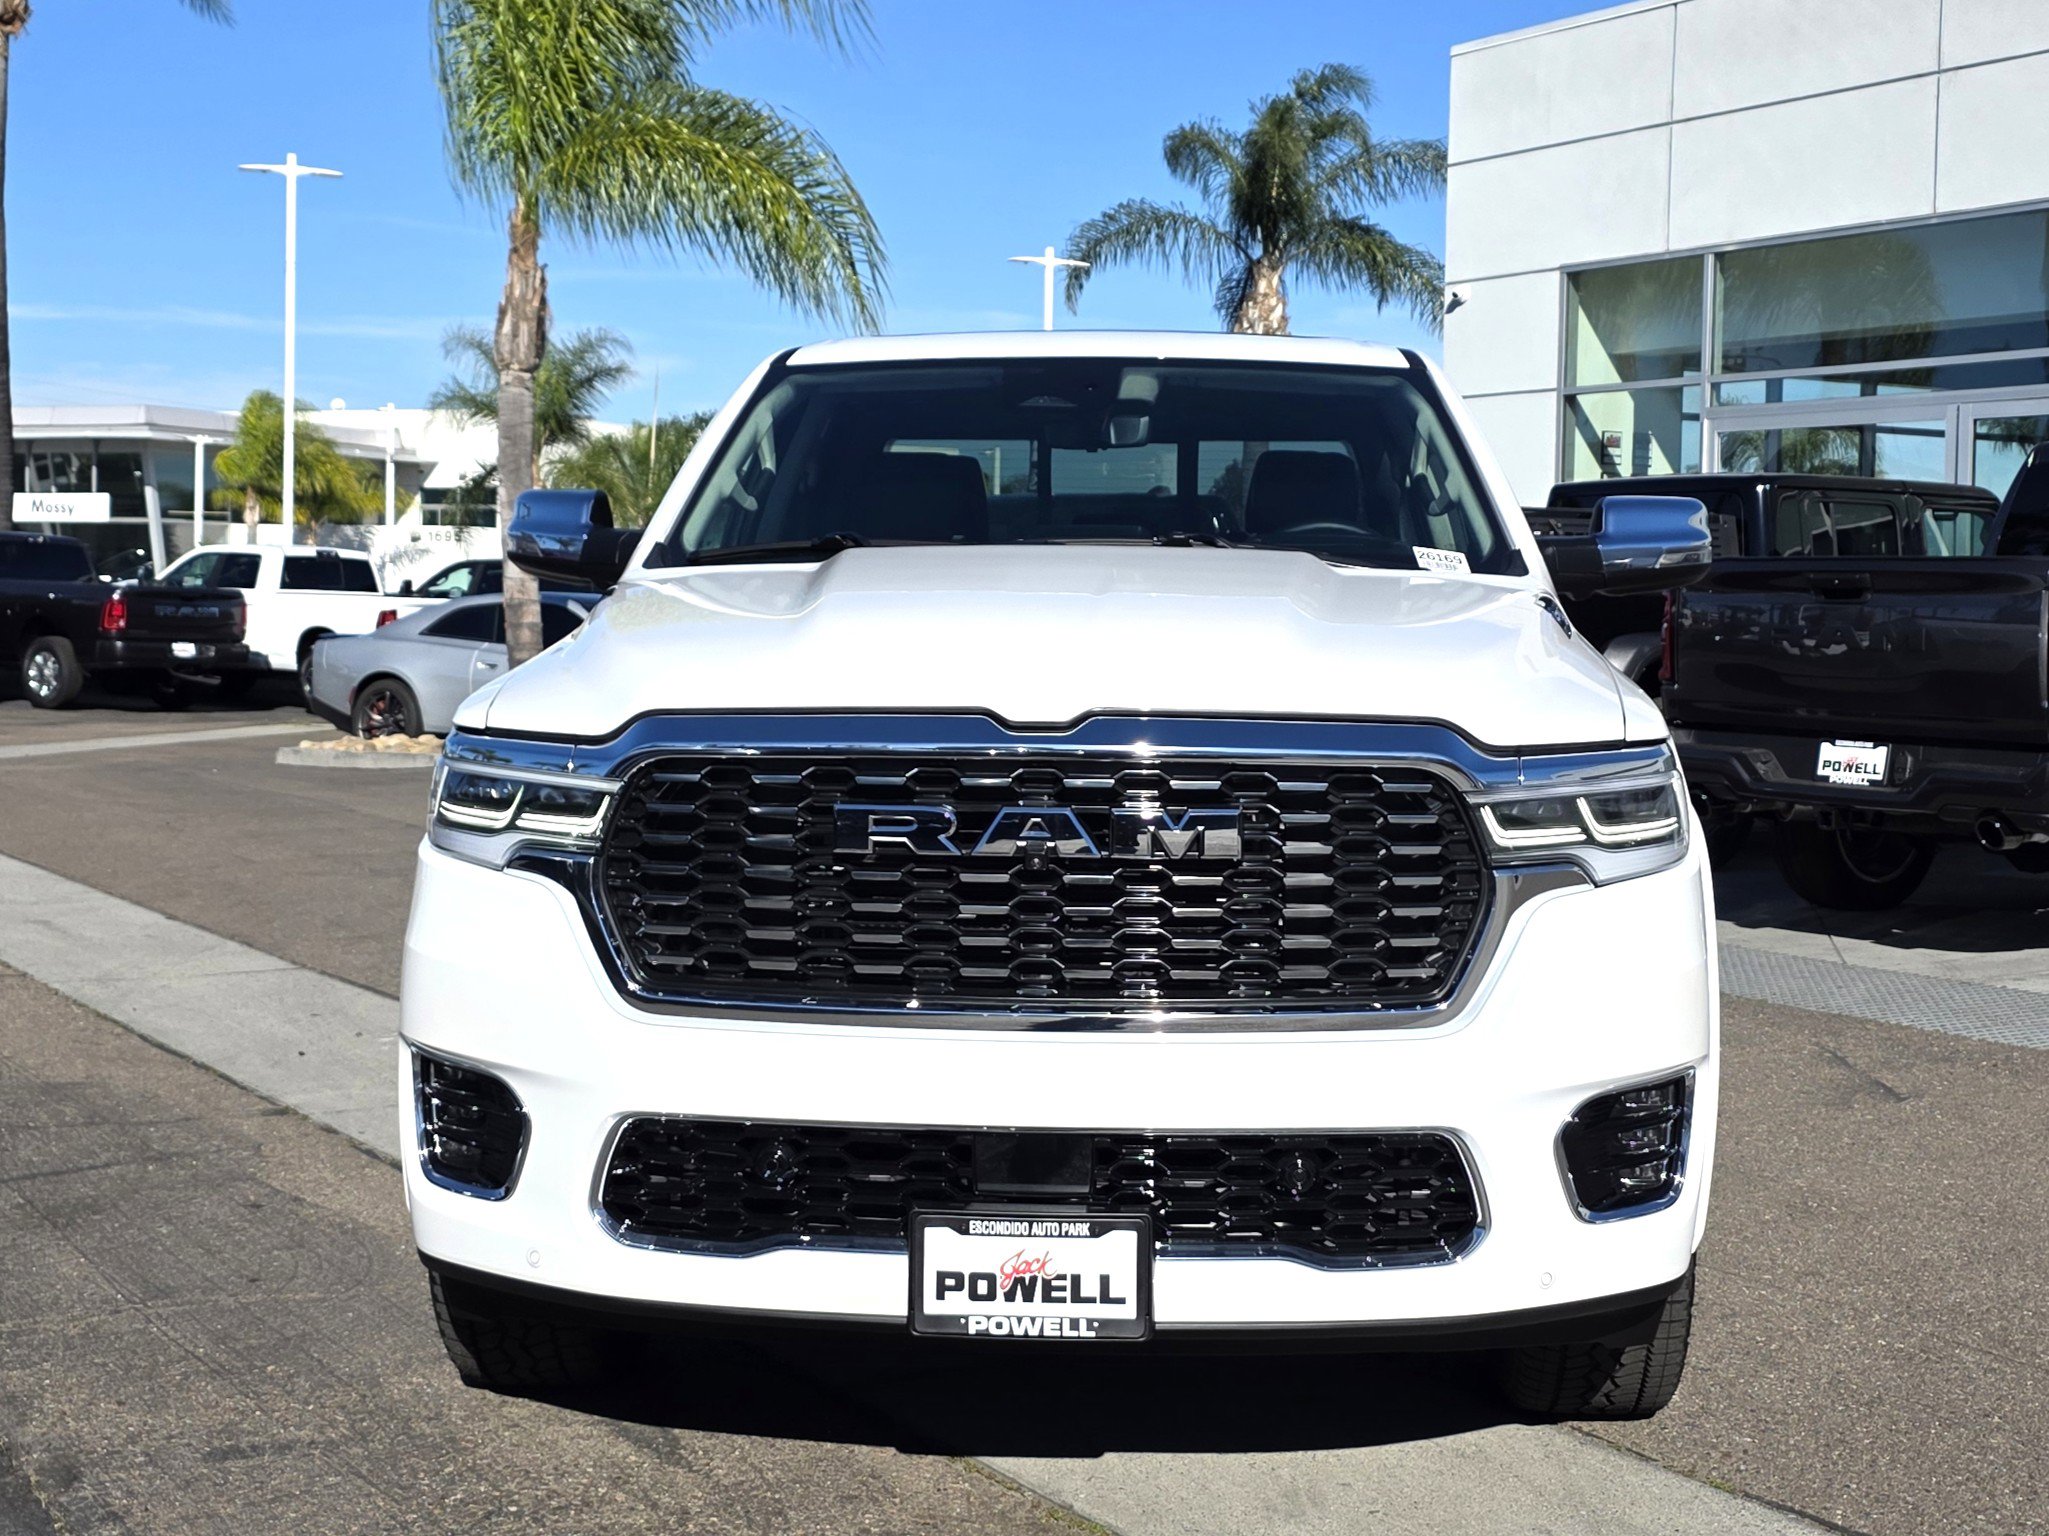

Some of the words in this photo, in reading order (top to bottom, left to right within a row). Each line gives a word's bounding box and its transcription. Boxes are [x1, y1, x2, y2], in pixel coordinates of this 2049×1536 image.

[31, 499, 75, 516] Mossy
[1417, 551, 1462, 564] 26169
[1822, 760, 1881, 775] POWELL
[833, 803, 1242, 859] RAM
[968, 1220, 1030, 1236] ESCONDIDO
[1031, 1221, 1060, 1237] AUTO
[1061, 1222, 1091, 1237] PARK
[1000, 1249, 1057, 1290] Jack
[936, 1270, 1127, 1305] POWELL
[967, 1315, 1097, 1338] POWELL
